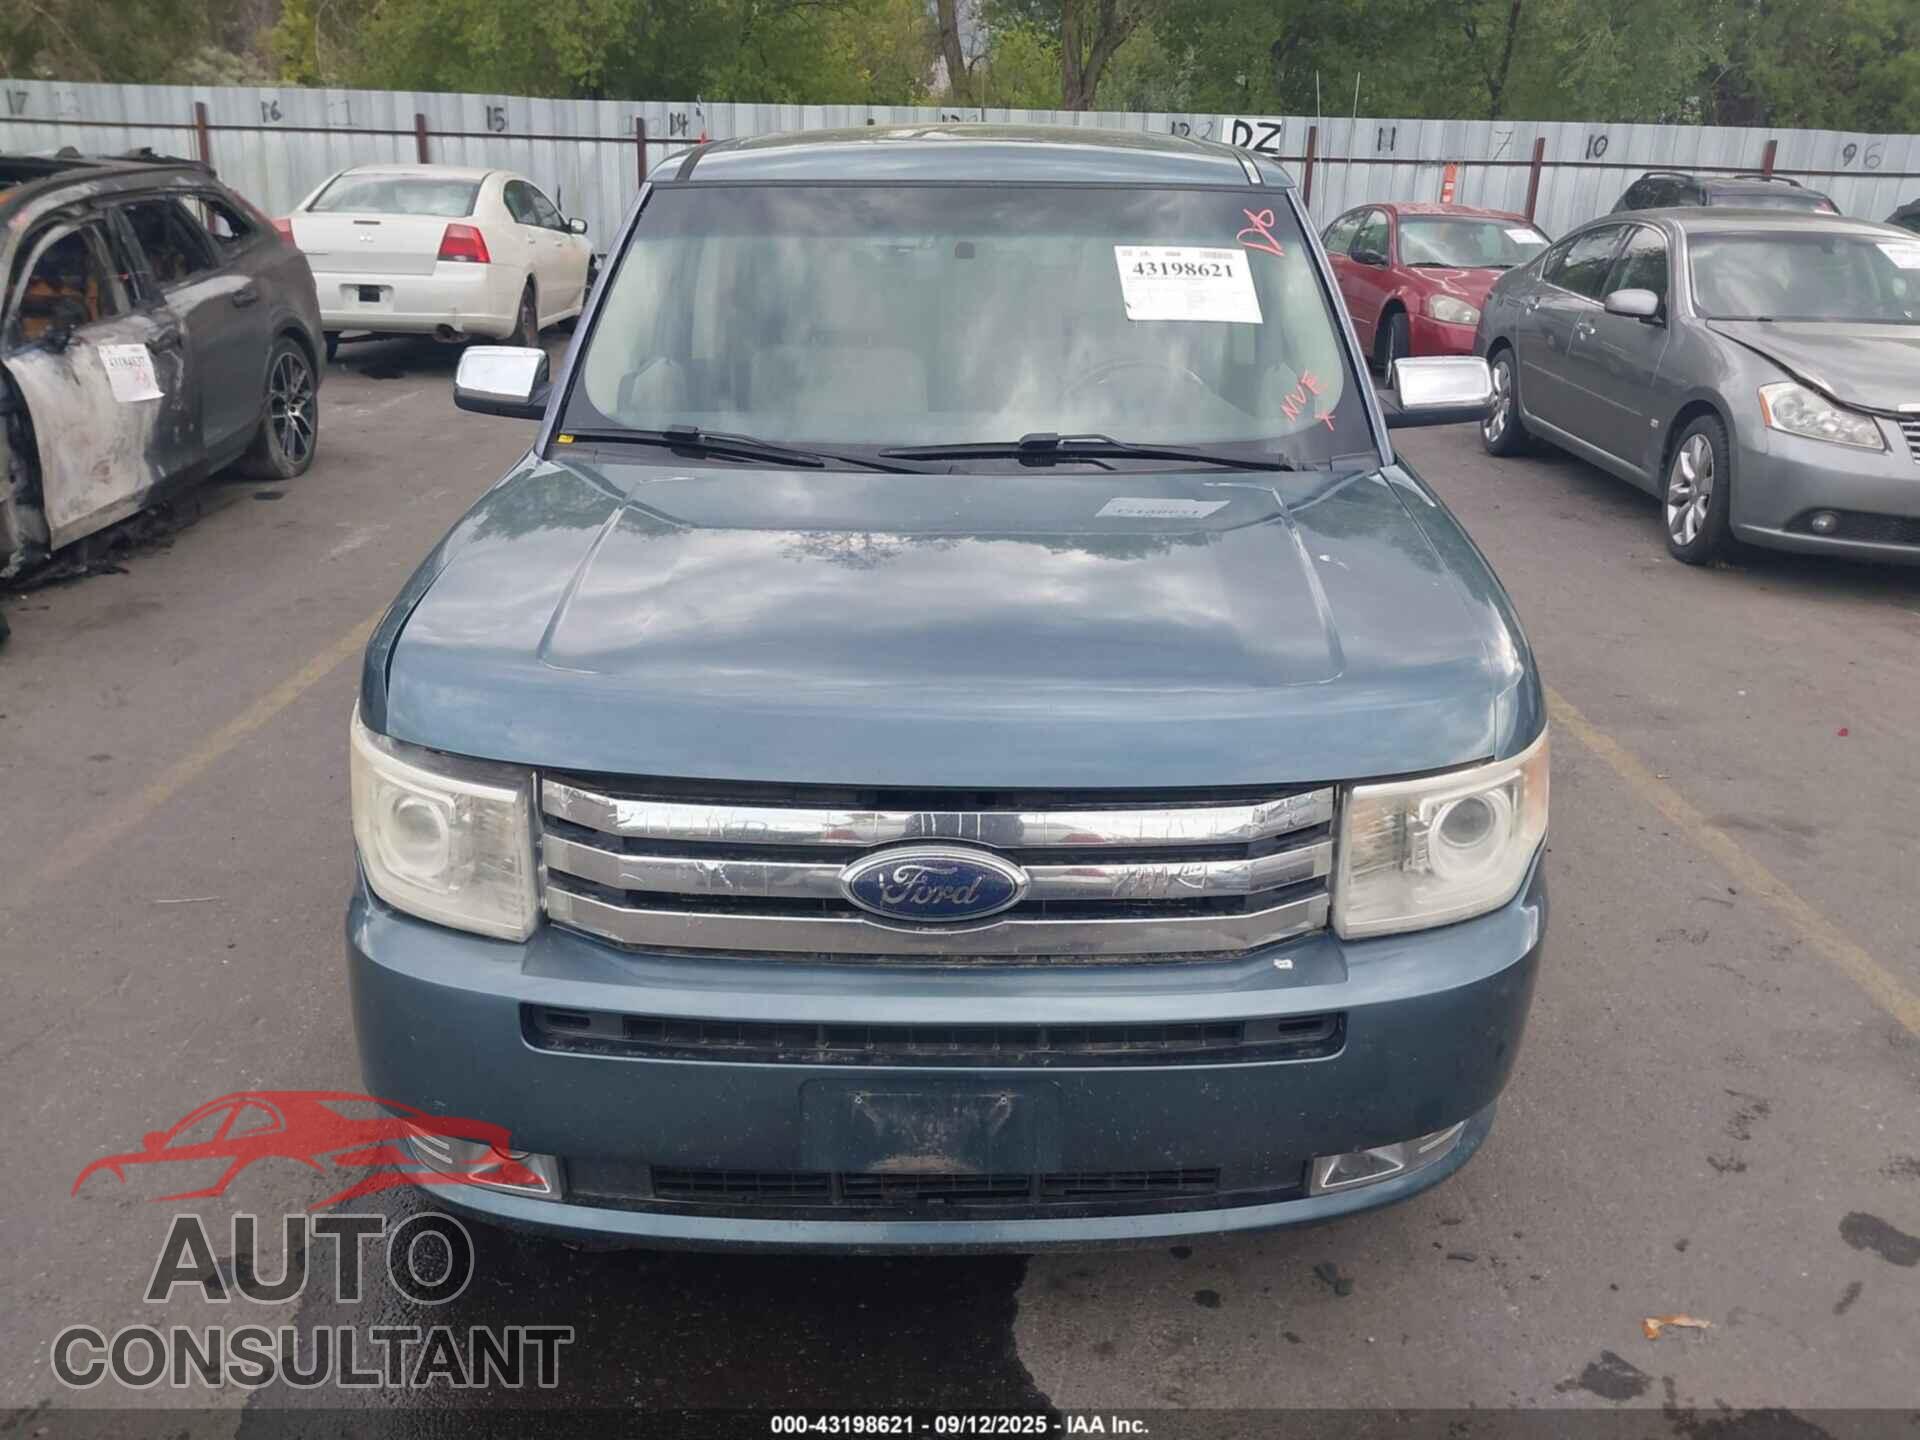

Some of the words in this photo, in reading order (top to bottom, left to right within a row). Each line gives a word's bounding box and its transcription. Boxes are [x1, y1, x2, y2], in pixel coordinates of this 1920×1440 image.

[6, 88, 29, 116] 17
[260, 99, 283, 123] 16
[485, 105, 506, 132] 15
[1377, 127, 1397, 152] 11
[1585, 134, 1609, 160] 10
[1132, 261, 1233, 278] 43198621
[881, 864, 985, 905] Ford
